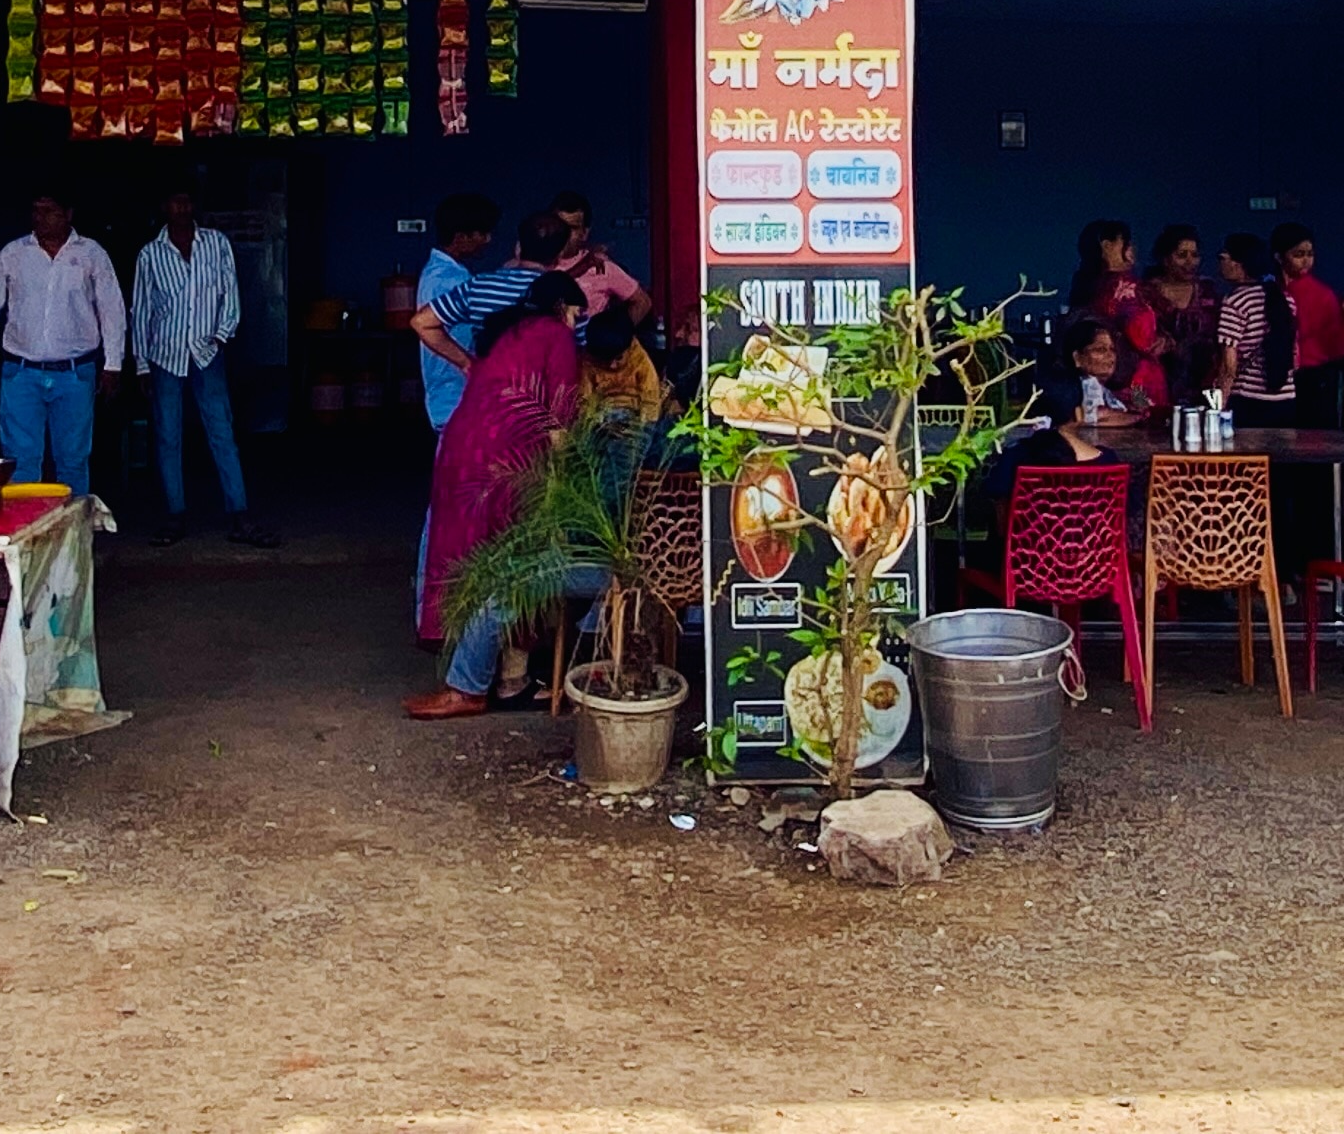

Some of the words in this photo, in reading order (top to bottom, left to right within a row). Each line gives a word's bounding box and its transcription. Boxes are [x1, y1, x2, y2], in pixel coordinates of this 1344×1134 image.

[773, 31, 902, 99] नर्मदा
[783, 109, 815, 144] AC
[738, 279, 806, 329] SOUTH
[812, 279, 881, 326] INDIAN
